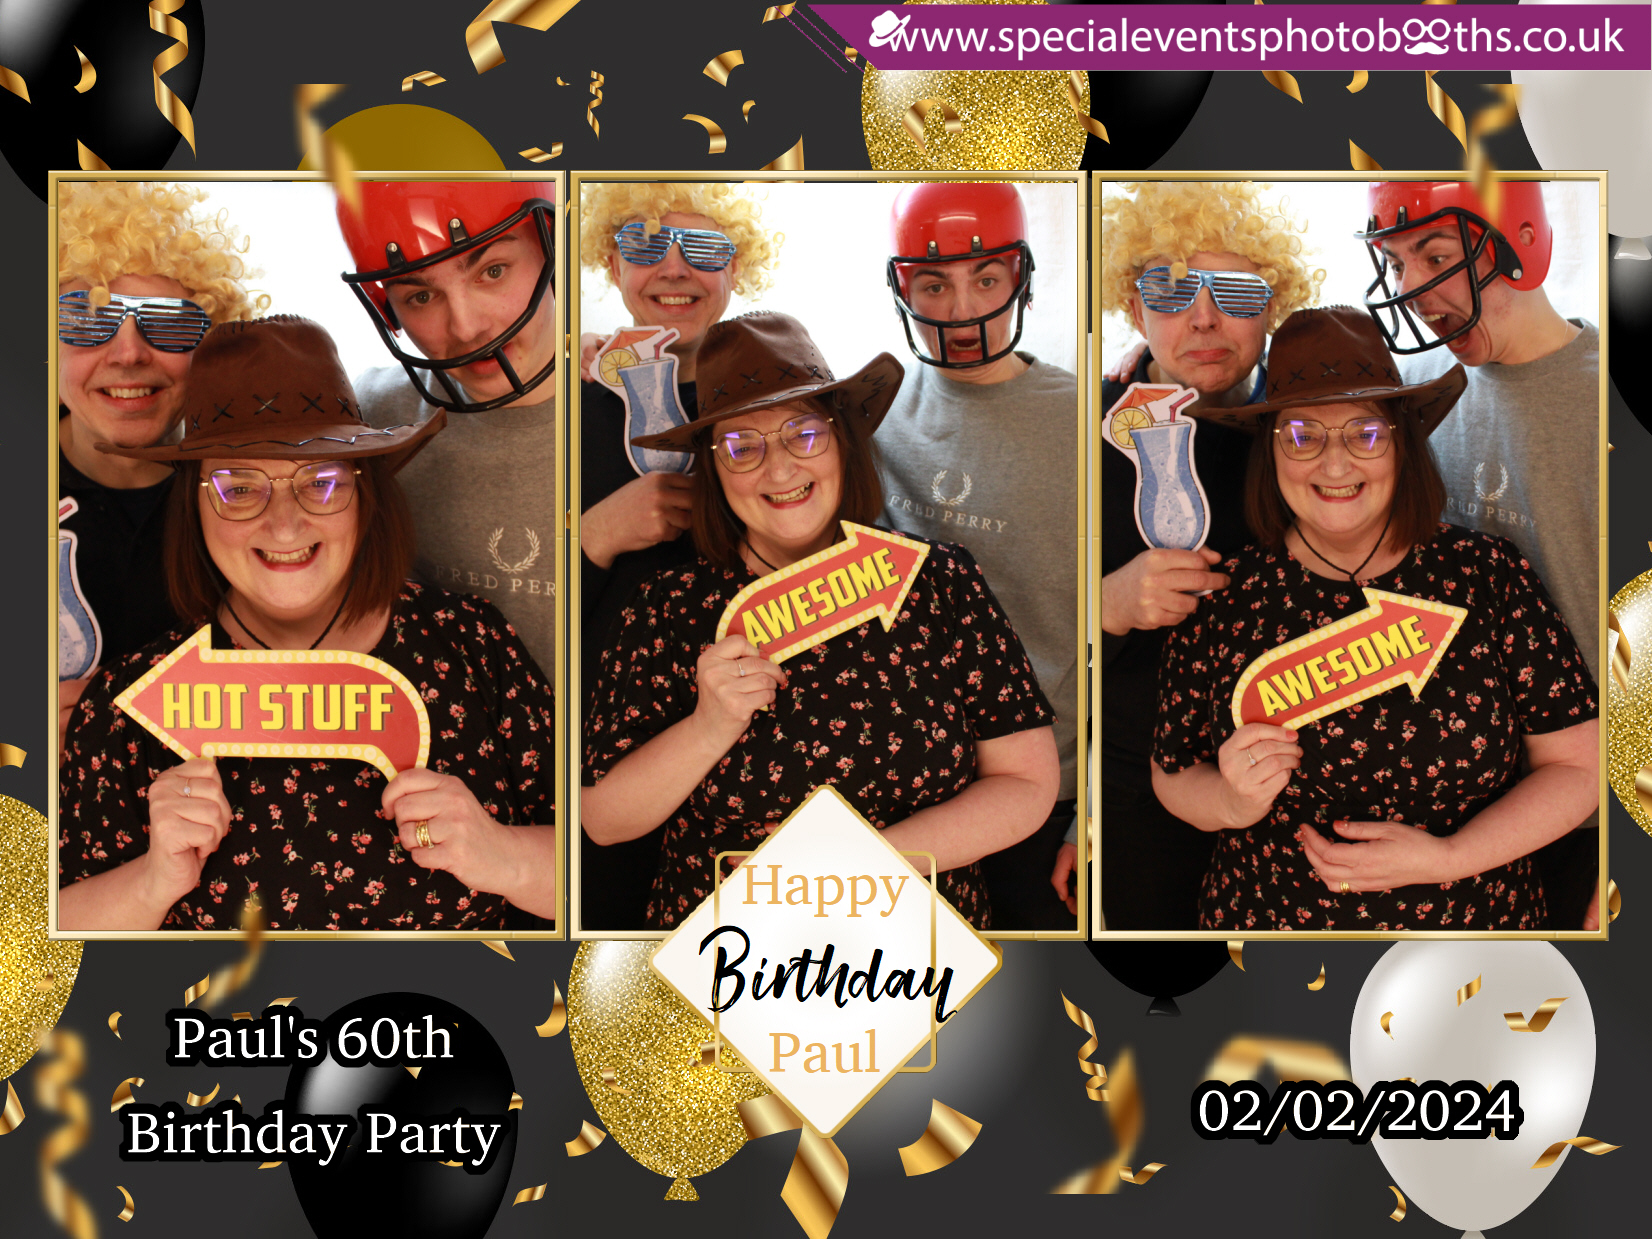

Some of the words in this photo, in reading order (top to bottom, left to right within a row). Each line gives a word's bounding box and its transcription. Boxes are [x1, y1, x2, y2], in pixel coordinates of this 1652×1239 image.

[887, 495, 935, 518] FRED
[942, 510, 1008, 533] PERRY
[1484, 506, 1538, 528] PERRY
[741, 547, 901, 650] AWESOME
[1256, 614, 1432, 718] AWESOME
[162, 683, 248, 730] HOT
[258, 683, 395, 732] STUFF
